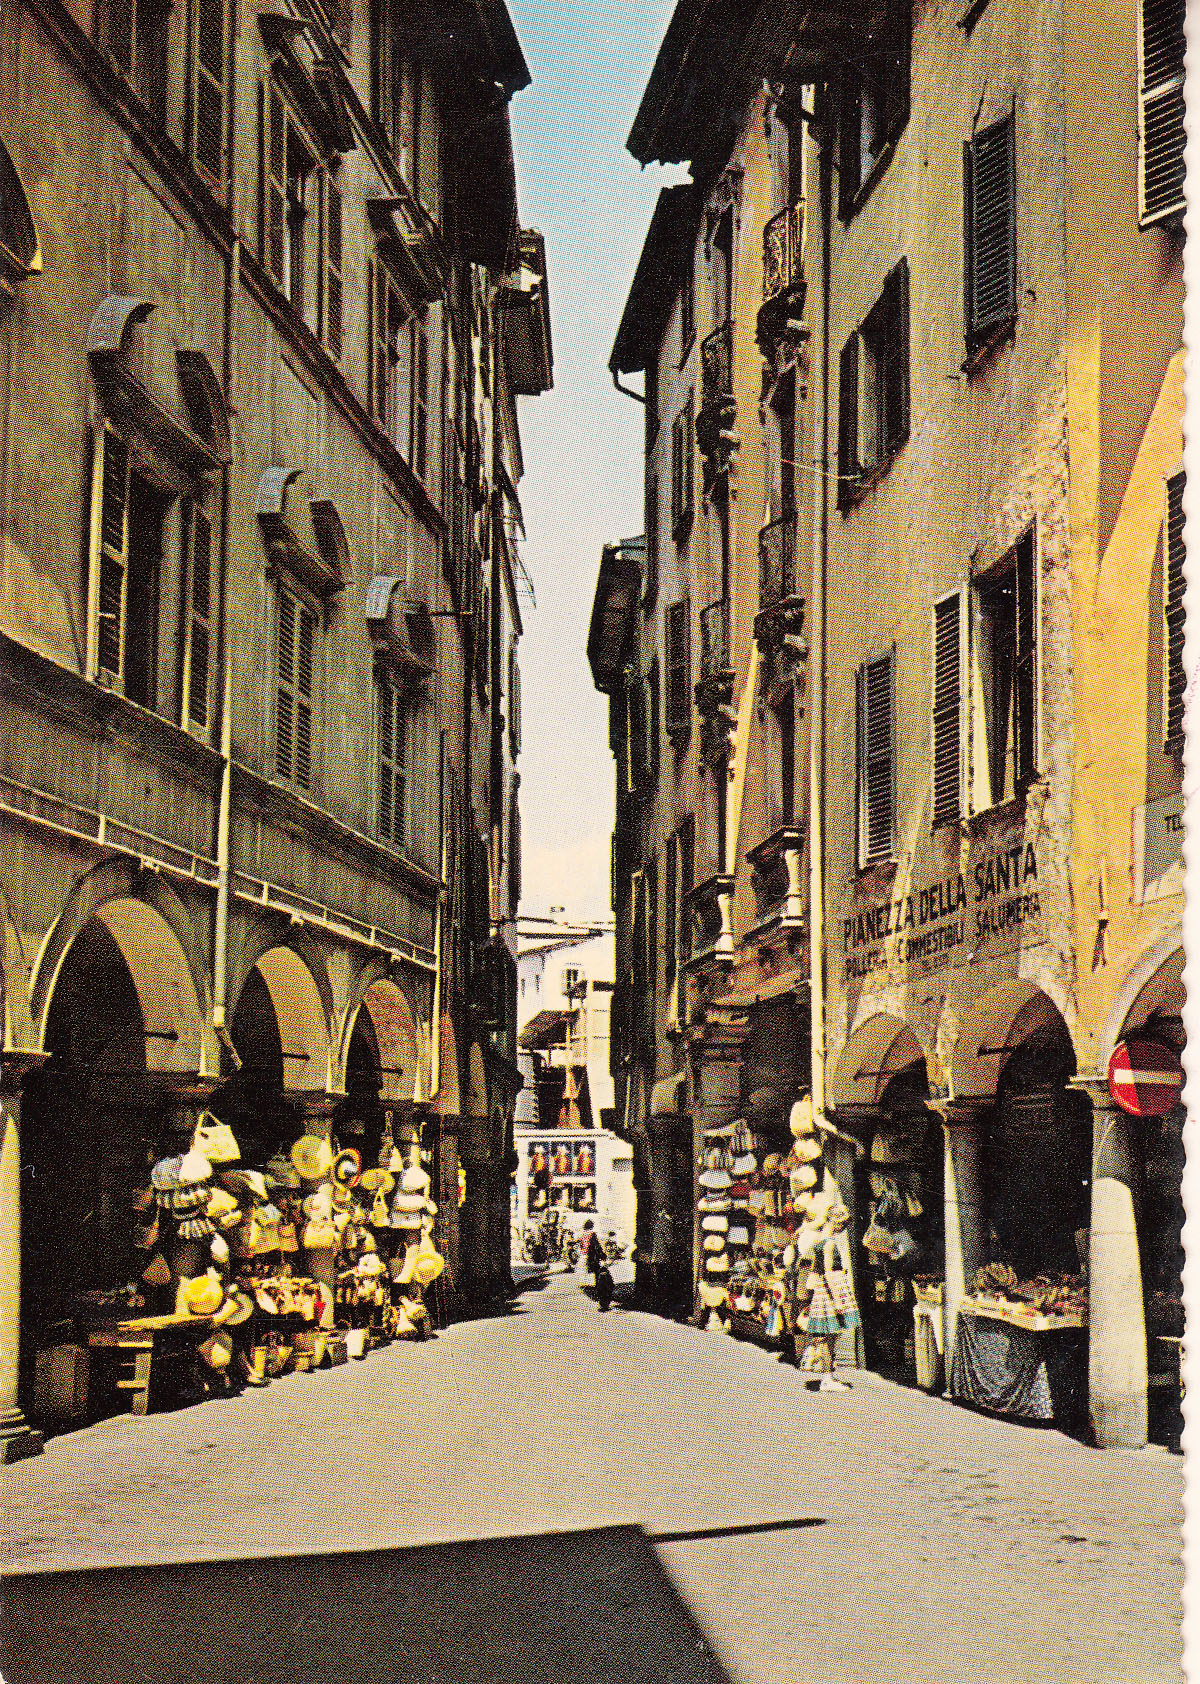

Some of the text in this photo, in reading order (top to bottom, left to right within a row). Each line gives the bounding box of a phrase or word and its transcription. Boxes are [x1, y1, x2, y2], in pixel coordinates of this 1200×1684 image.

[843, 842, 1038, 953] PIANEZZA DELLA SANTA
